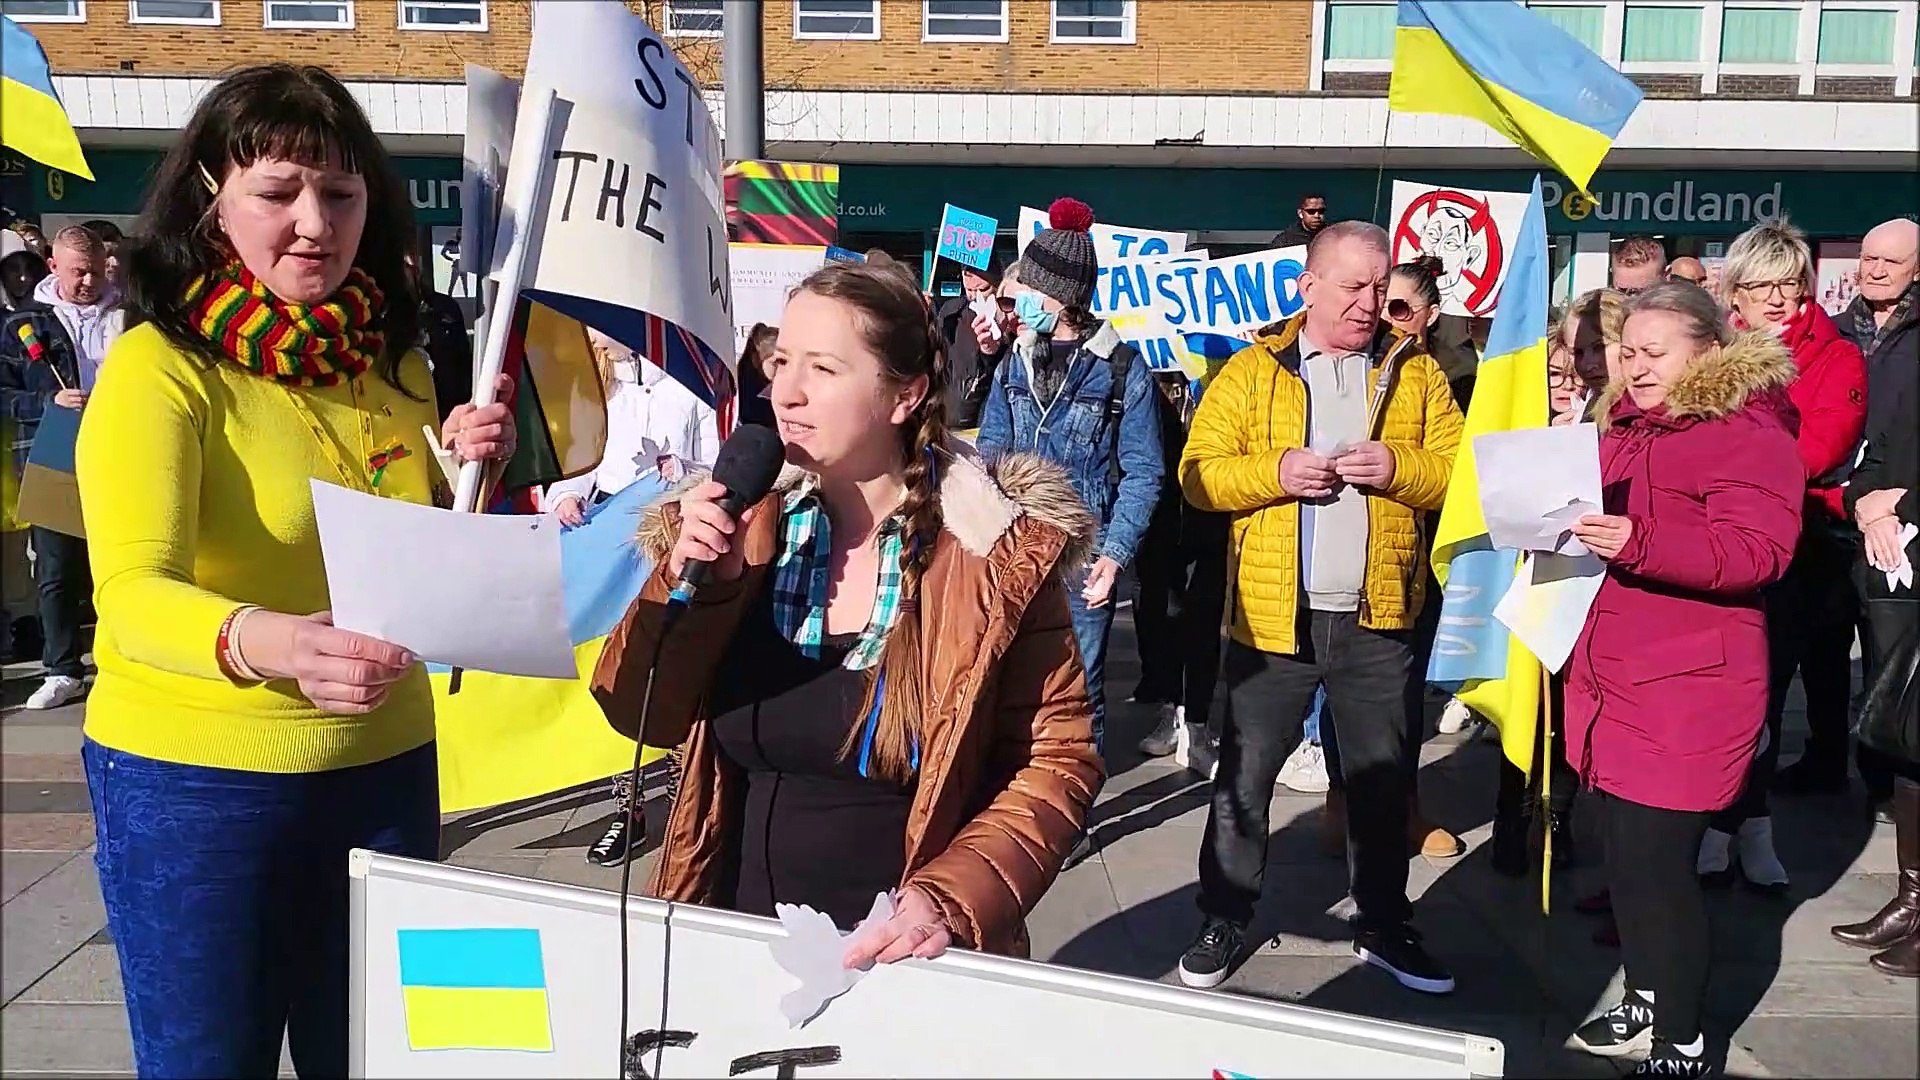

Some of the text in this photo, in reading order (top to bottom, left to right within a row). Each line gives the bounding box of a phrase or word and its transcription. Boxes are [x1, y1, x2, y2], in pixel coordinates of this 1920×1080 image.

[553, 150, 667, 243] THE
[942, 223, 993, 254] STOP
[949, 248, 979, 265] PUTIN
[1156, 259, 1305, 327] STAND
[593, 822, 624, 856] DKNY
